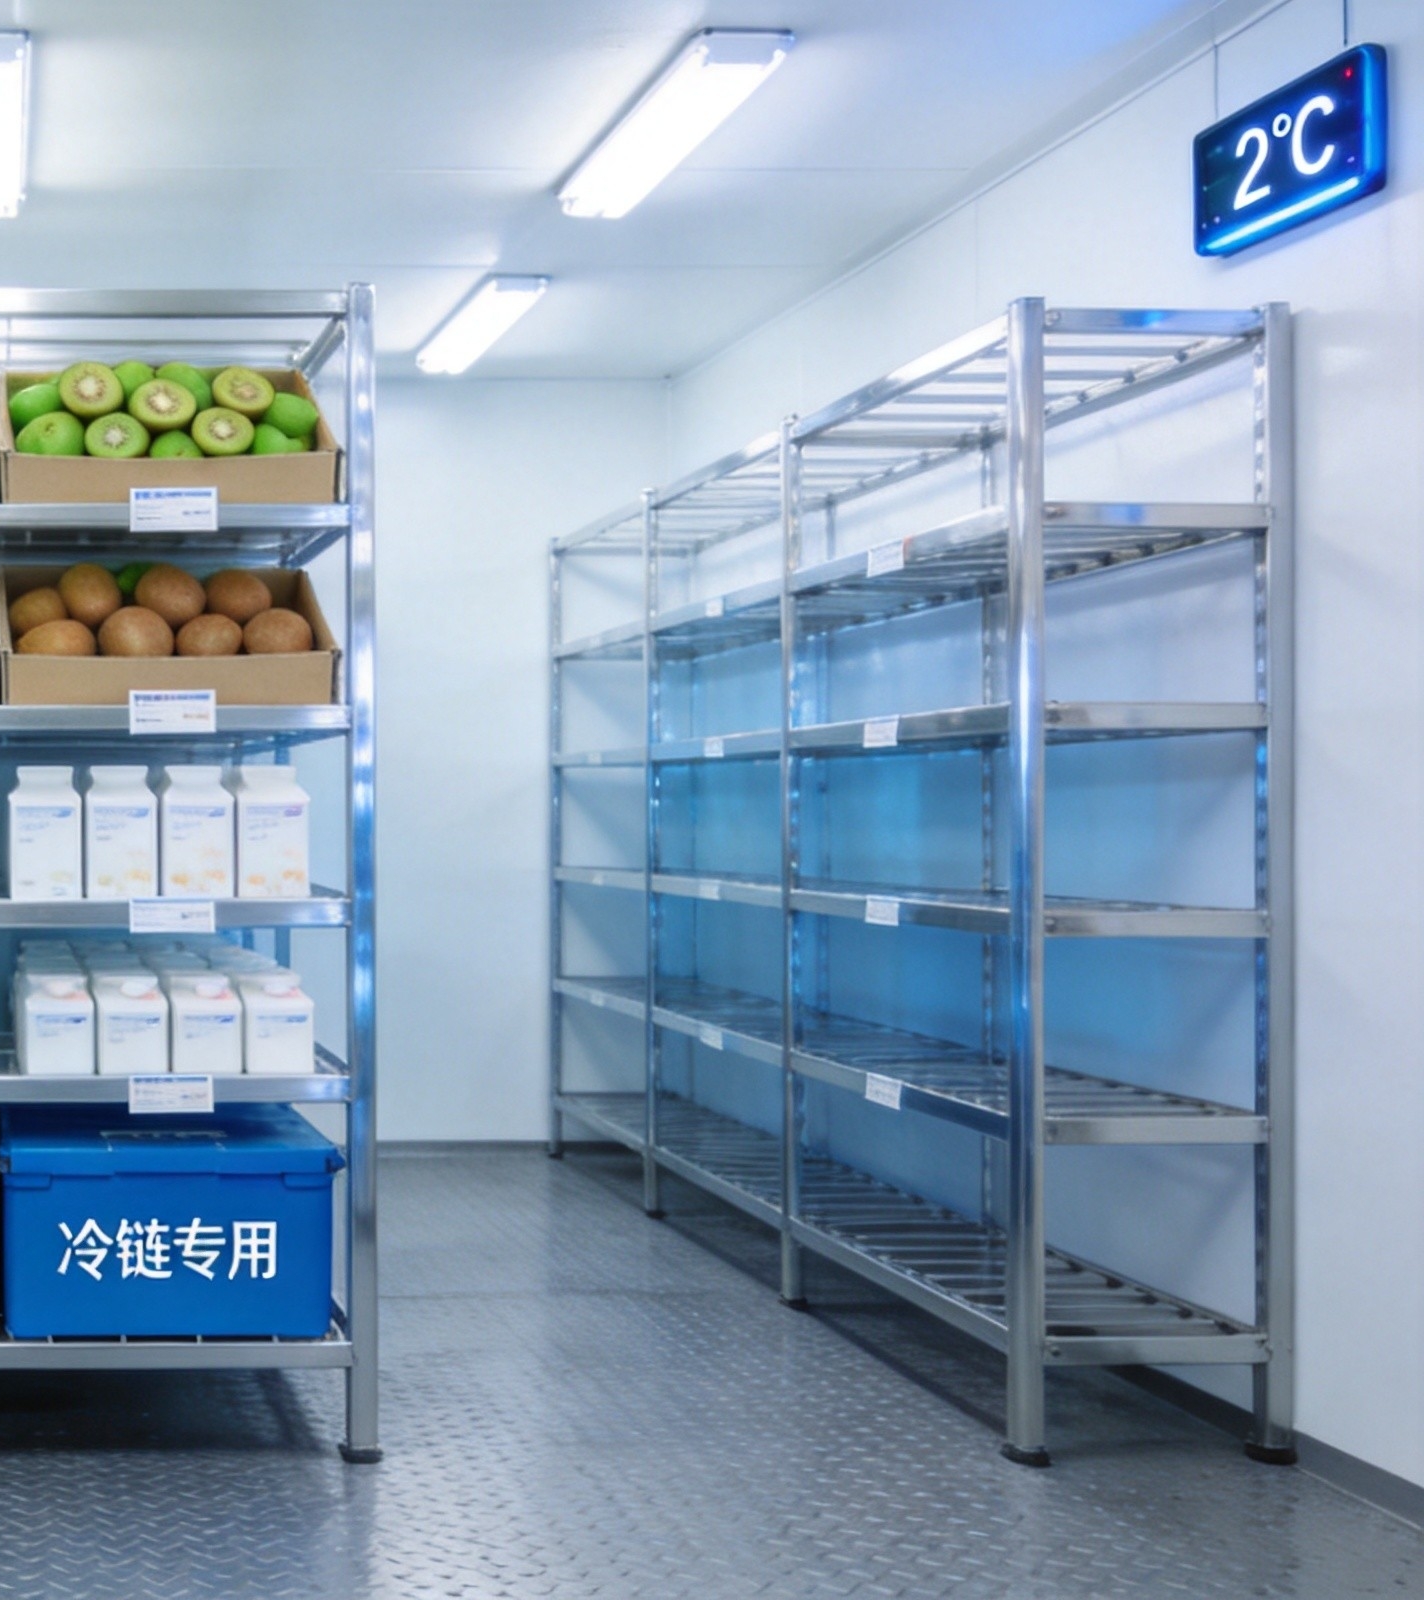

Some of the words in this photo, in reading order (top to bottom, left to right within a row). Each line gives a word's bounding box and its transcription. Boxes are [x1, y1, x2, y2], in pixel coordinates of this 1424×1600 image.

[1233, 95, 1335, 210] 2°C
[58, 1218, 276, 1280] 冷链专用
